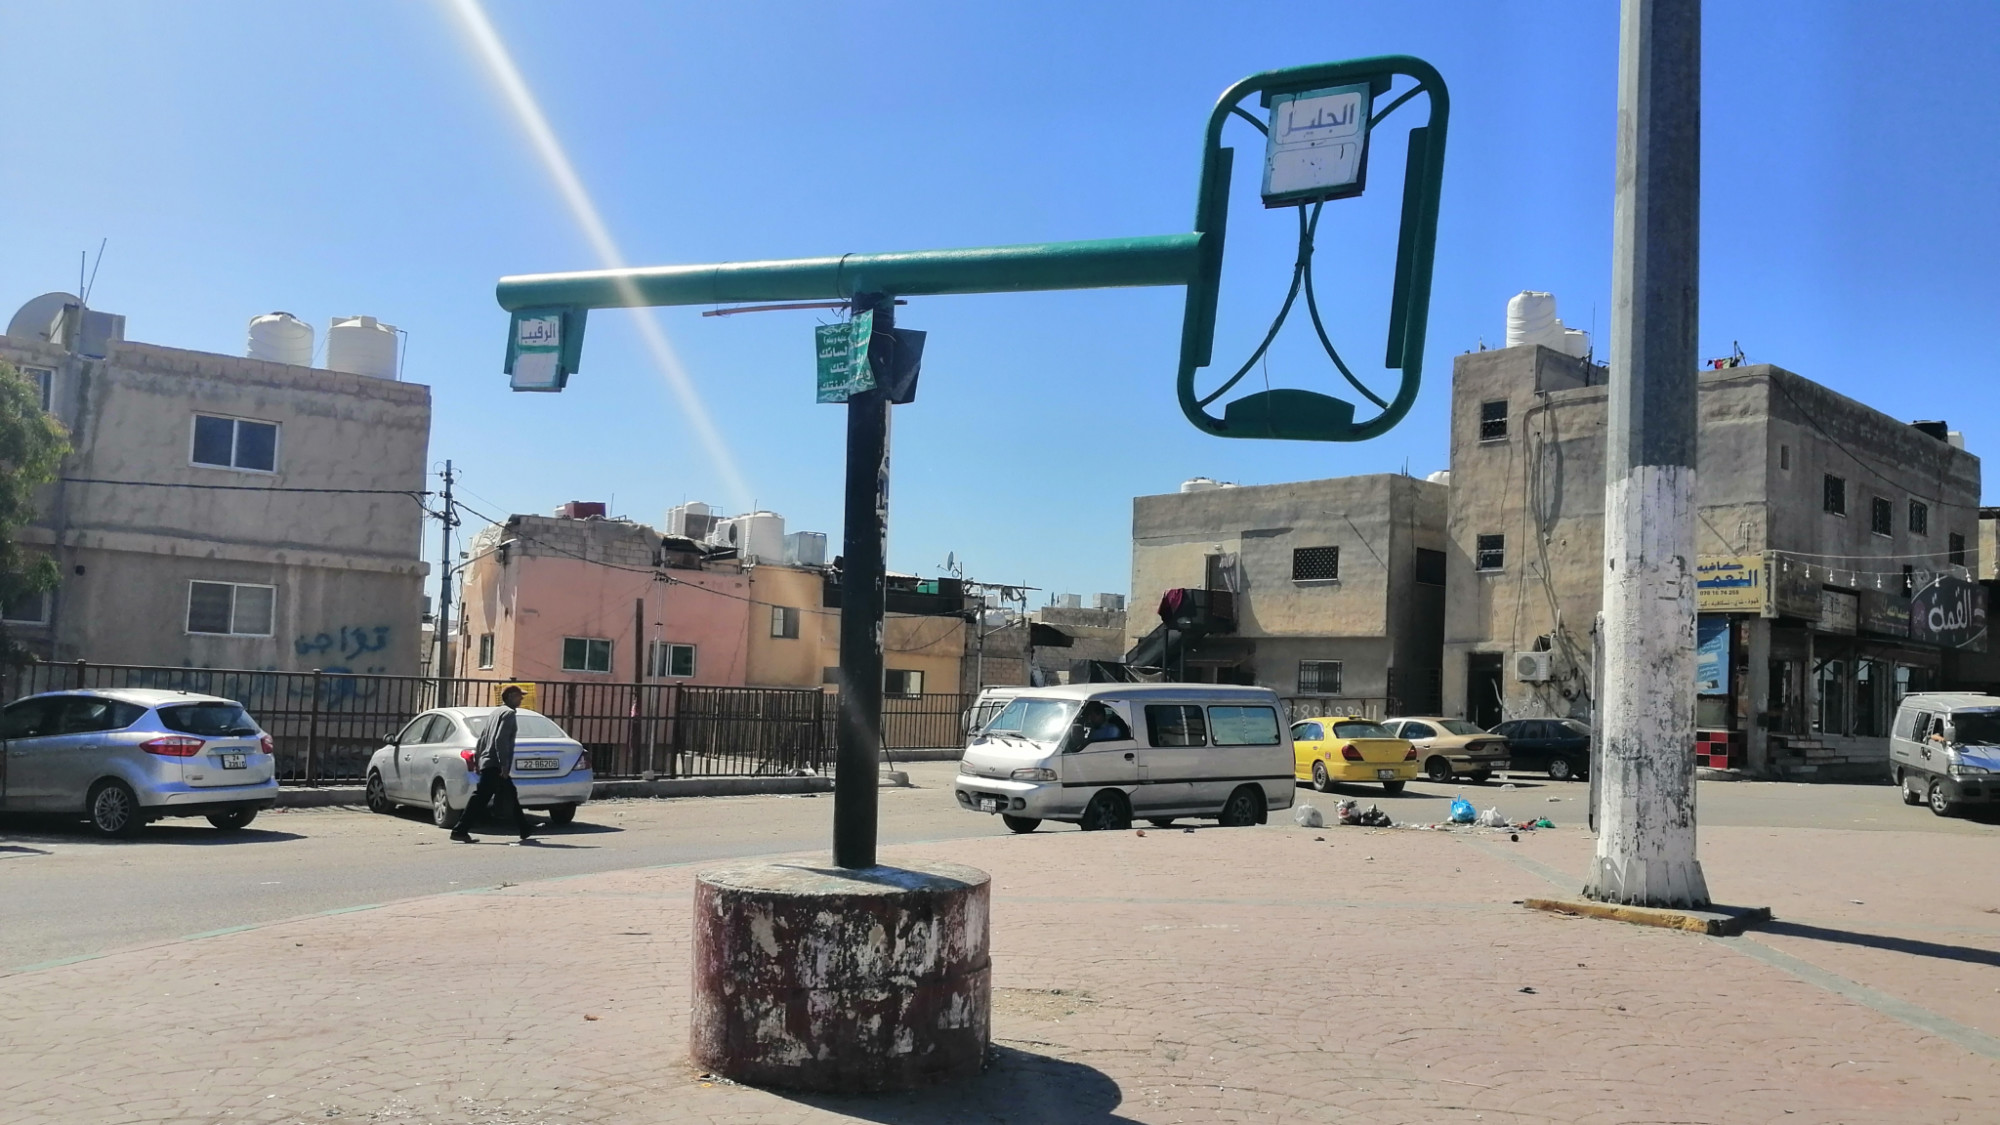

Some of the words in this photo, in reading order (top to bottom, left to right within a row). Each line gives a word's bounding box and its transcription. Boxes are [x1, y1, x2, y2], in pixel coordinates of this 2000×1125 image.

[1281, 103, 1355, 138] الجليل
[521, 321, 556, 344] الرقيب
[1928, 586, 1972, 633] القمة
